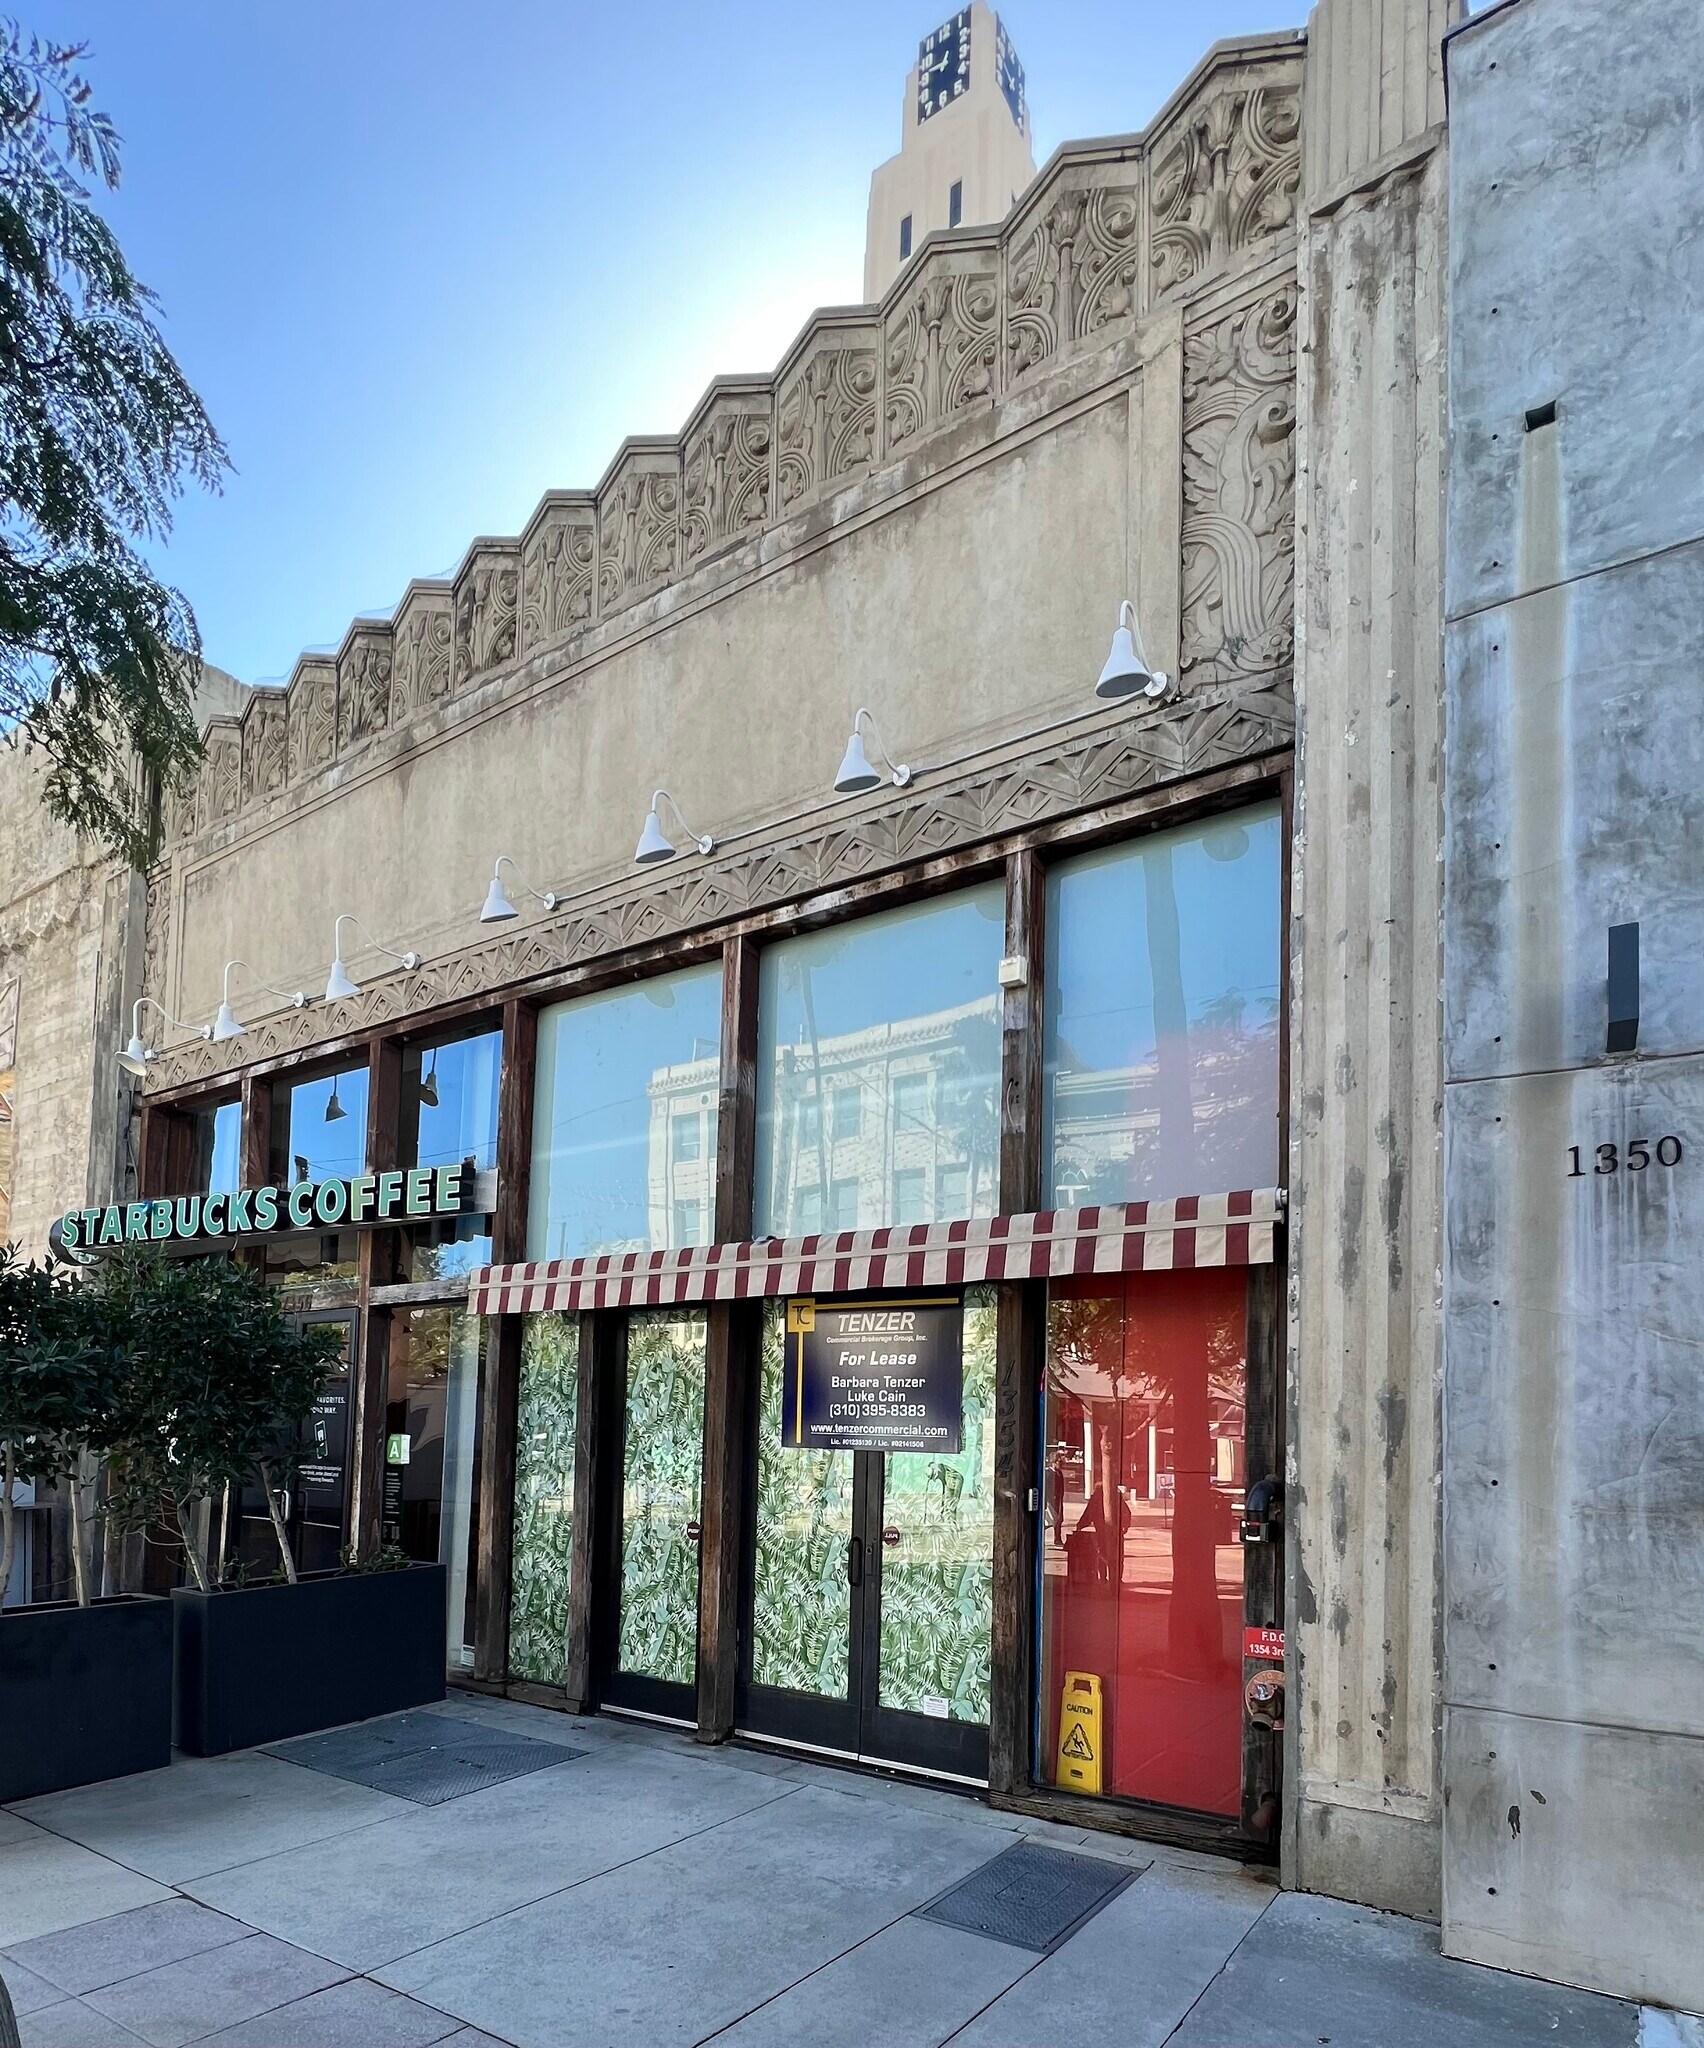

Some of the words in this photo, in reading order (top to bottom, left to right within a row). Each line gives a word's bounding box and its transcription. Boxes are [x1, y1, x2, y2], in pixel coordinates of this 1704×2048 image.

[939, 23, 951, 43] 12
[921, 52, 933, 70] 10
[1566, 1135, 1683, 1178] 1350
[60, 1186, 278, 1249] STARBUCKS
[287, 1164, 463, 1227] COFFEE
[838, 1312, 916, 1333] TENZER
[826, 1336, 860, 1344] Commercial
[861, 1335, 892, 1344] Brokerage
[839, 1351, 865, 1366] For
[869, 1350, 917, 1366] Lease
[831, 1376, 879, 1388] Barbara
[883, 1376, 926, 1388] Tenzer
[847, 1390, 875, 1402] Luke
[878, 1390, 906, 1402] Cain
[862, 1404, 926, 1417] 395-8383
[810, 1423, 948, 1436] www.tenzercommercial.com
[389, 1441, 400, 1457] A
[1249, 1644, 1270, 1655] 1354
[1066, 1703, 1093, 1716] CAUTION
